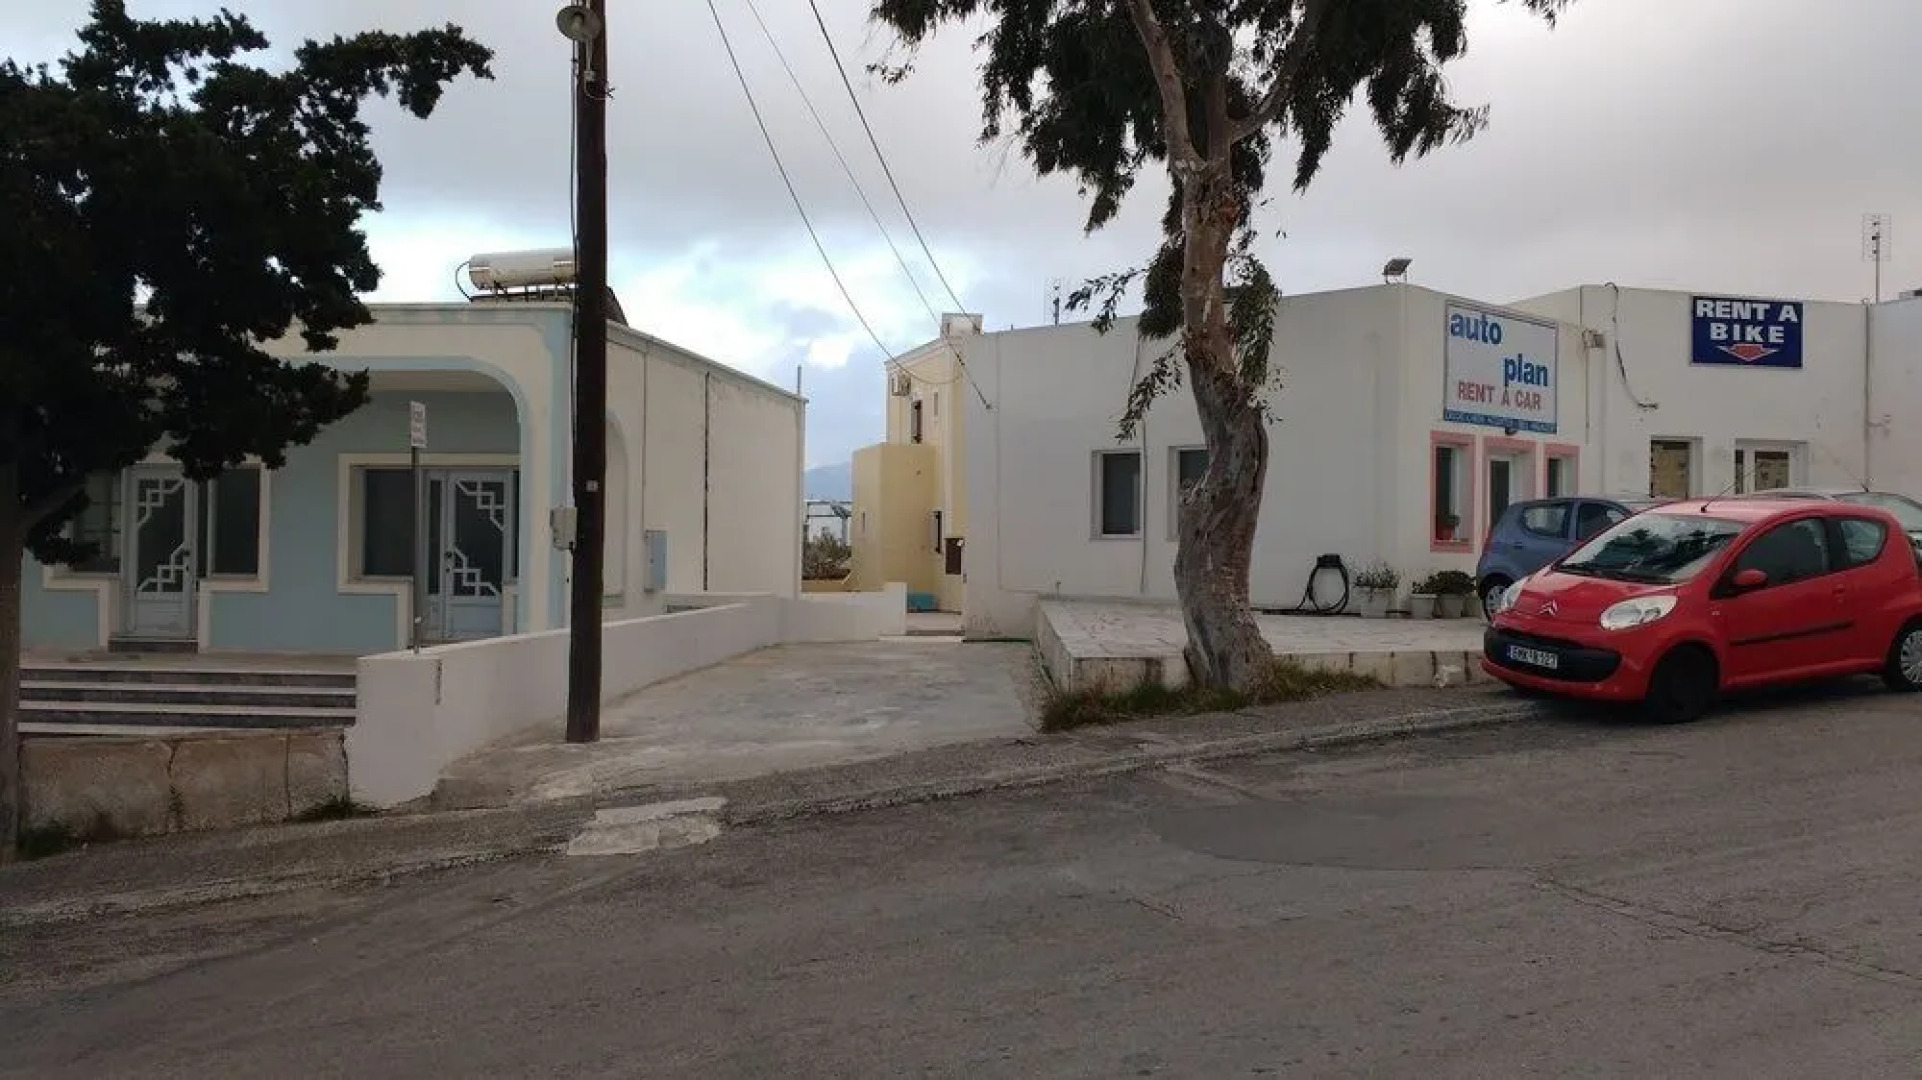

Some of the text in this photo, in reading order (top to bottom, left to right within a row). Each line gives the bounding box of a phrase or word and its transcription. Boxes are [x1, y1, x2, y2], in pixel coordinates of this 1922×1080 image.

[1696, 300, 1798, 322] RENT A
[1450, 313, 1502, 345] auto
[1710, 323, 1784, 343] BIKE
[1504, 353, 1548, 387] plan
[1458, 379, 1542, 411] RENT A CAR
